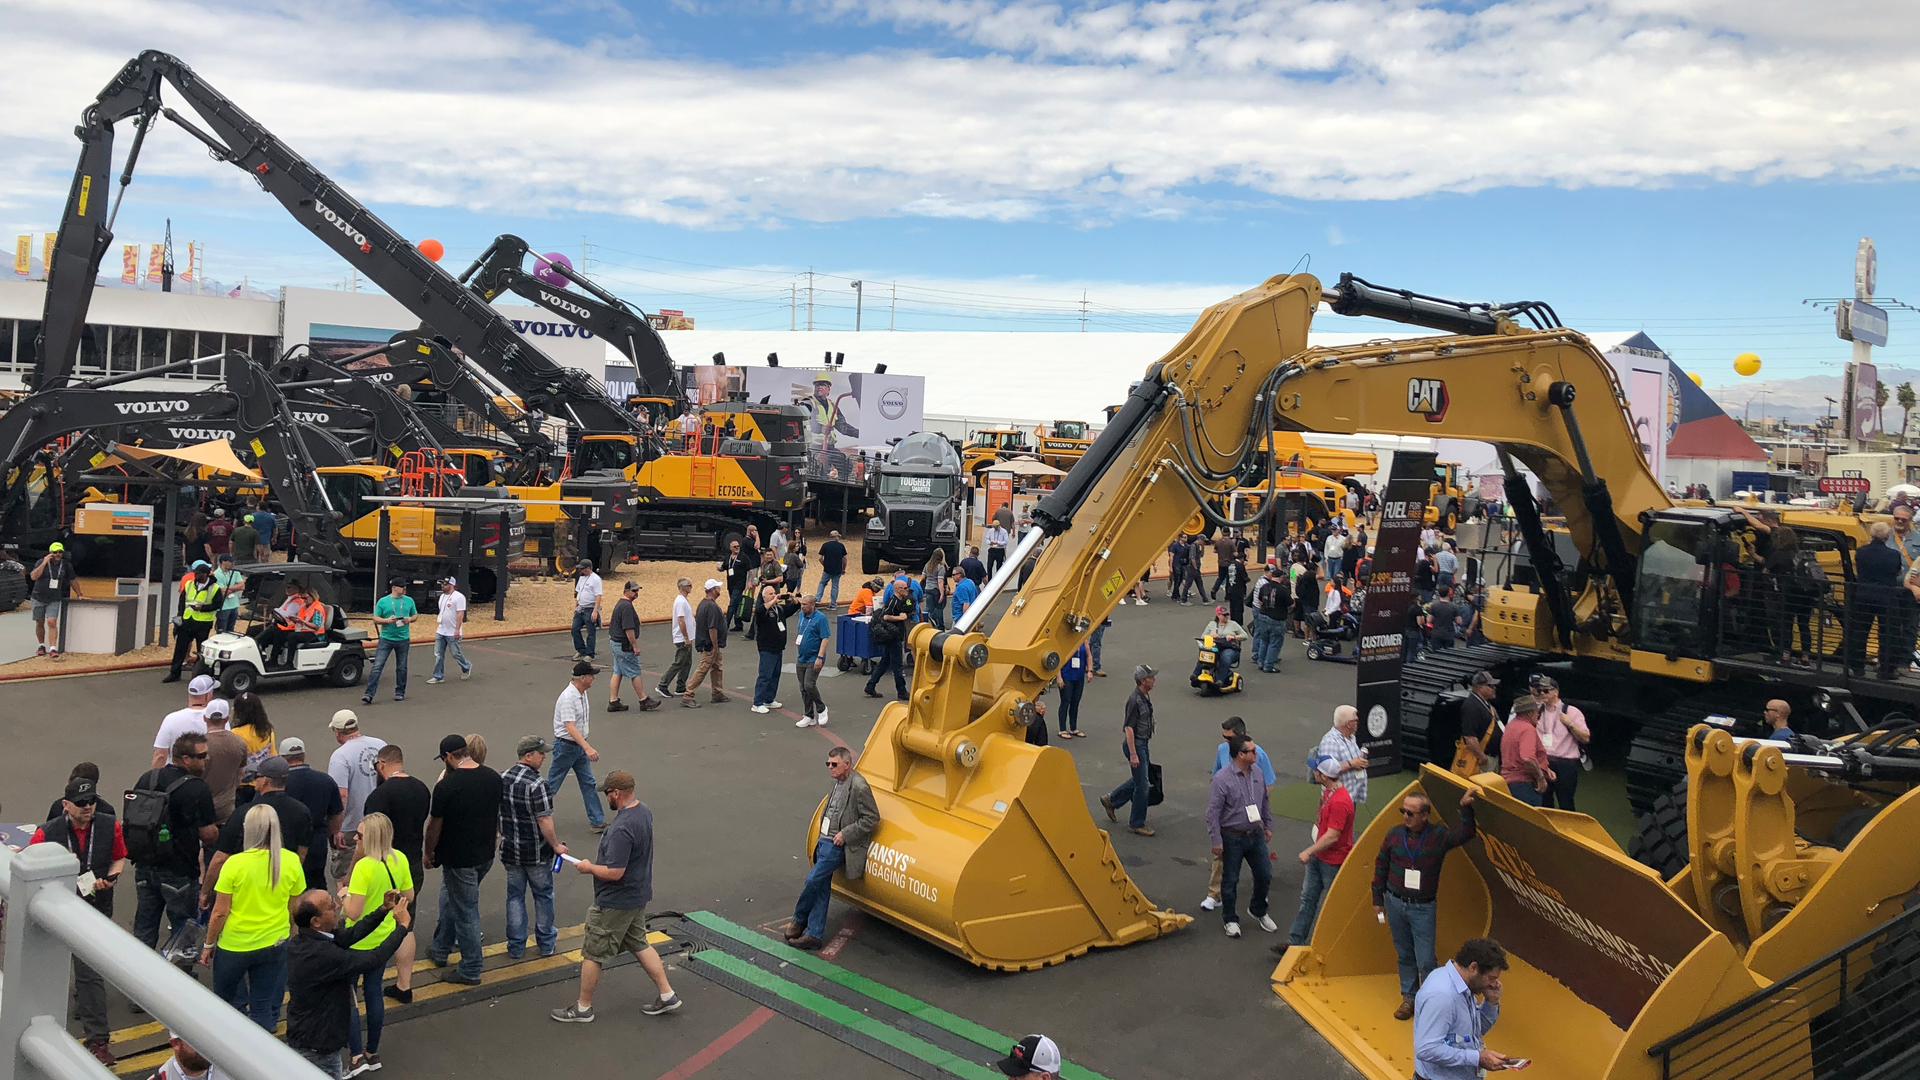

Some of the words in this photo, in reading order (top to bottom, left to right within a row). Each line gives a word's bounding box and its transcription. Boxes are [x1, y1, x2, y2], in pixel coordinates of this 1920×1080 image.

[314, 200, 367, 246] VOLVO
[539, 290, 591, 319] VOLVO
[511, 320, 595, 339] VOLVO
[1408, 378, 1441, 412] CAT
[114, 400, 190, 415] VOLVO
[168, 427, 236, 441] VOLVO
[900, 477, 931, 487] TOUGHER
[1843, 470, 1860, 478] CAT
[1383, 501, 1407, 519] FUEL
[1409, 502, 1422, 510] FOR
[1368, 584, 1410, 594] FINANCING
[1361, 633, 1403, 649] CUSTOMER
[908, 876, 938, 903] TOOLS
[1494, 866, 1654, 972] MAINTENANCE
[1592, 939, 1643, 976] SERVICE
